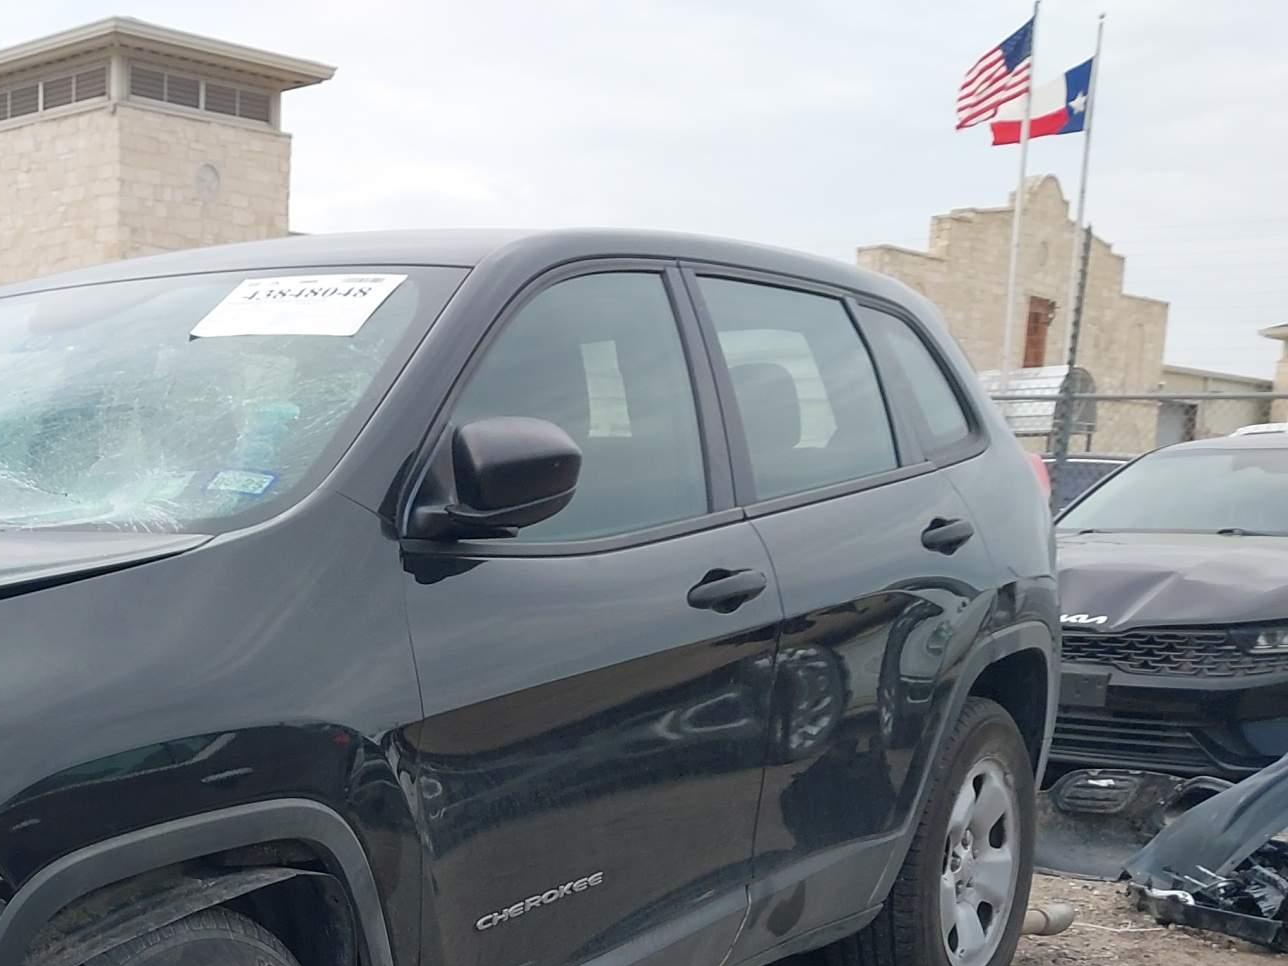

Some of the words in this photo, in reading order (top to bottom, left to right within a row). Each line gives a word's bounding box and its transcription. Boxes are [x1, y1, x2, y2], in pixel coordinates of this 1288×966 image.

[241, 286, 372, 302] 43848048
[1059, 613, 1108, 624] KIA
[476, 871, 604, 931] CHEROKEE
